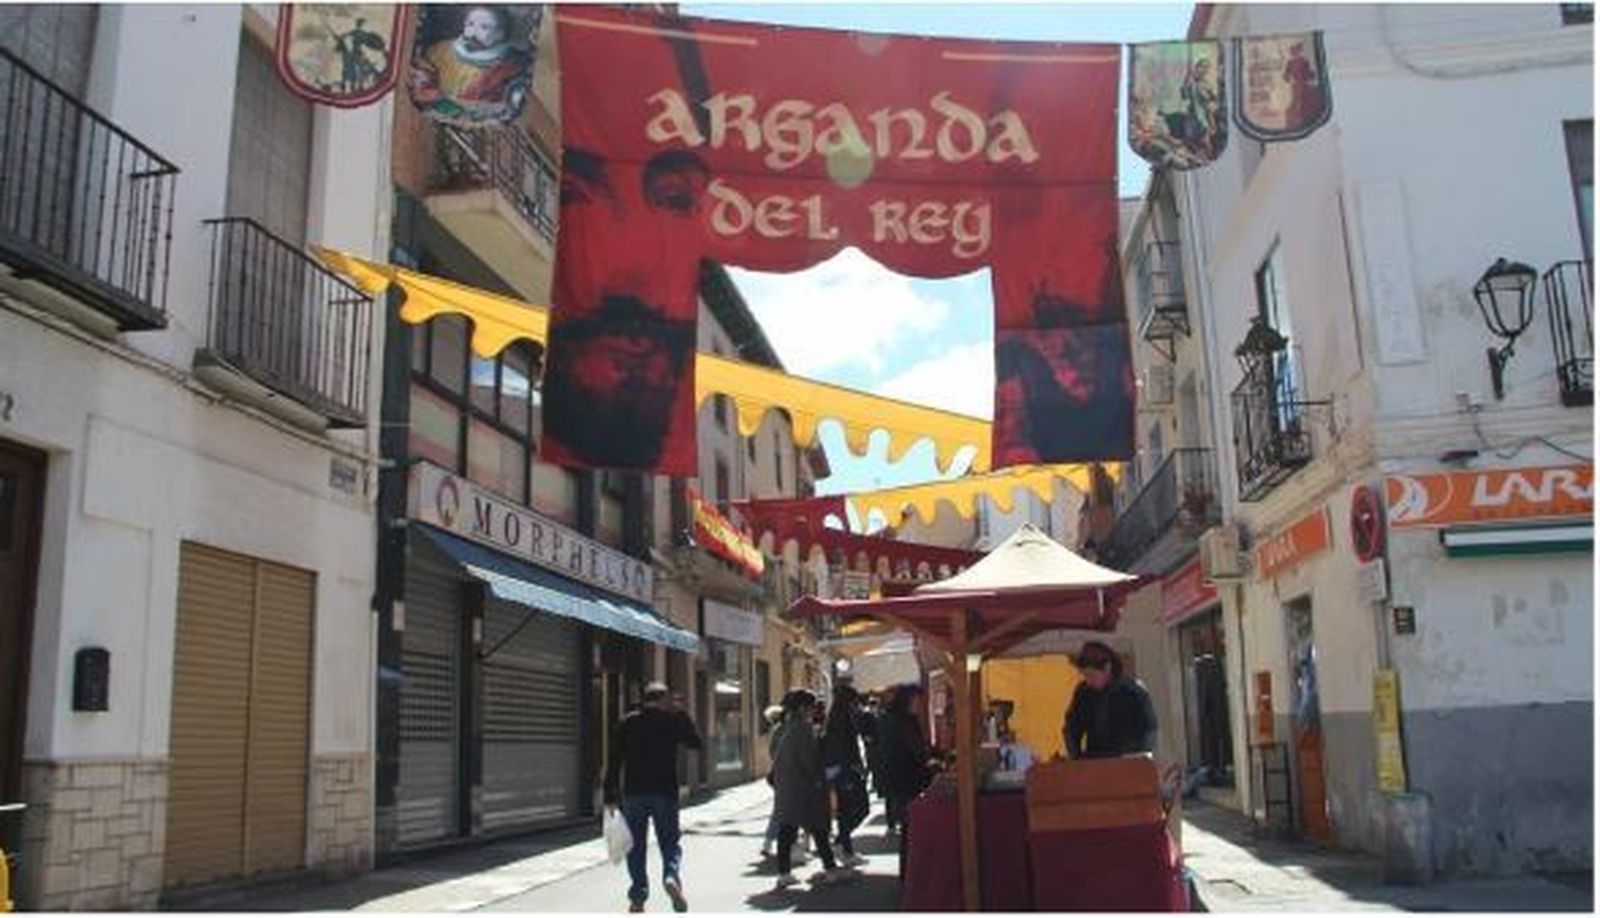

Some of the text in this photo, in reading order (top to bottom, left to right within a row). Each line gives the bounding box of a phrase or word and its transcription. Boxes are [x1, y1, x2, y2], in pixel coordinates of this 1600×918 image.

[645, 88, 1039, 170] ARGANDA
[707, 178, 993, 259] DEL REY
[1470, 467, 1594, 507] LAR
